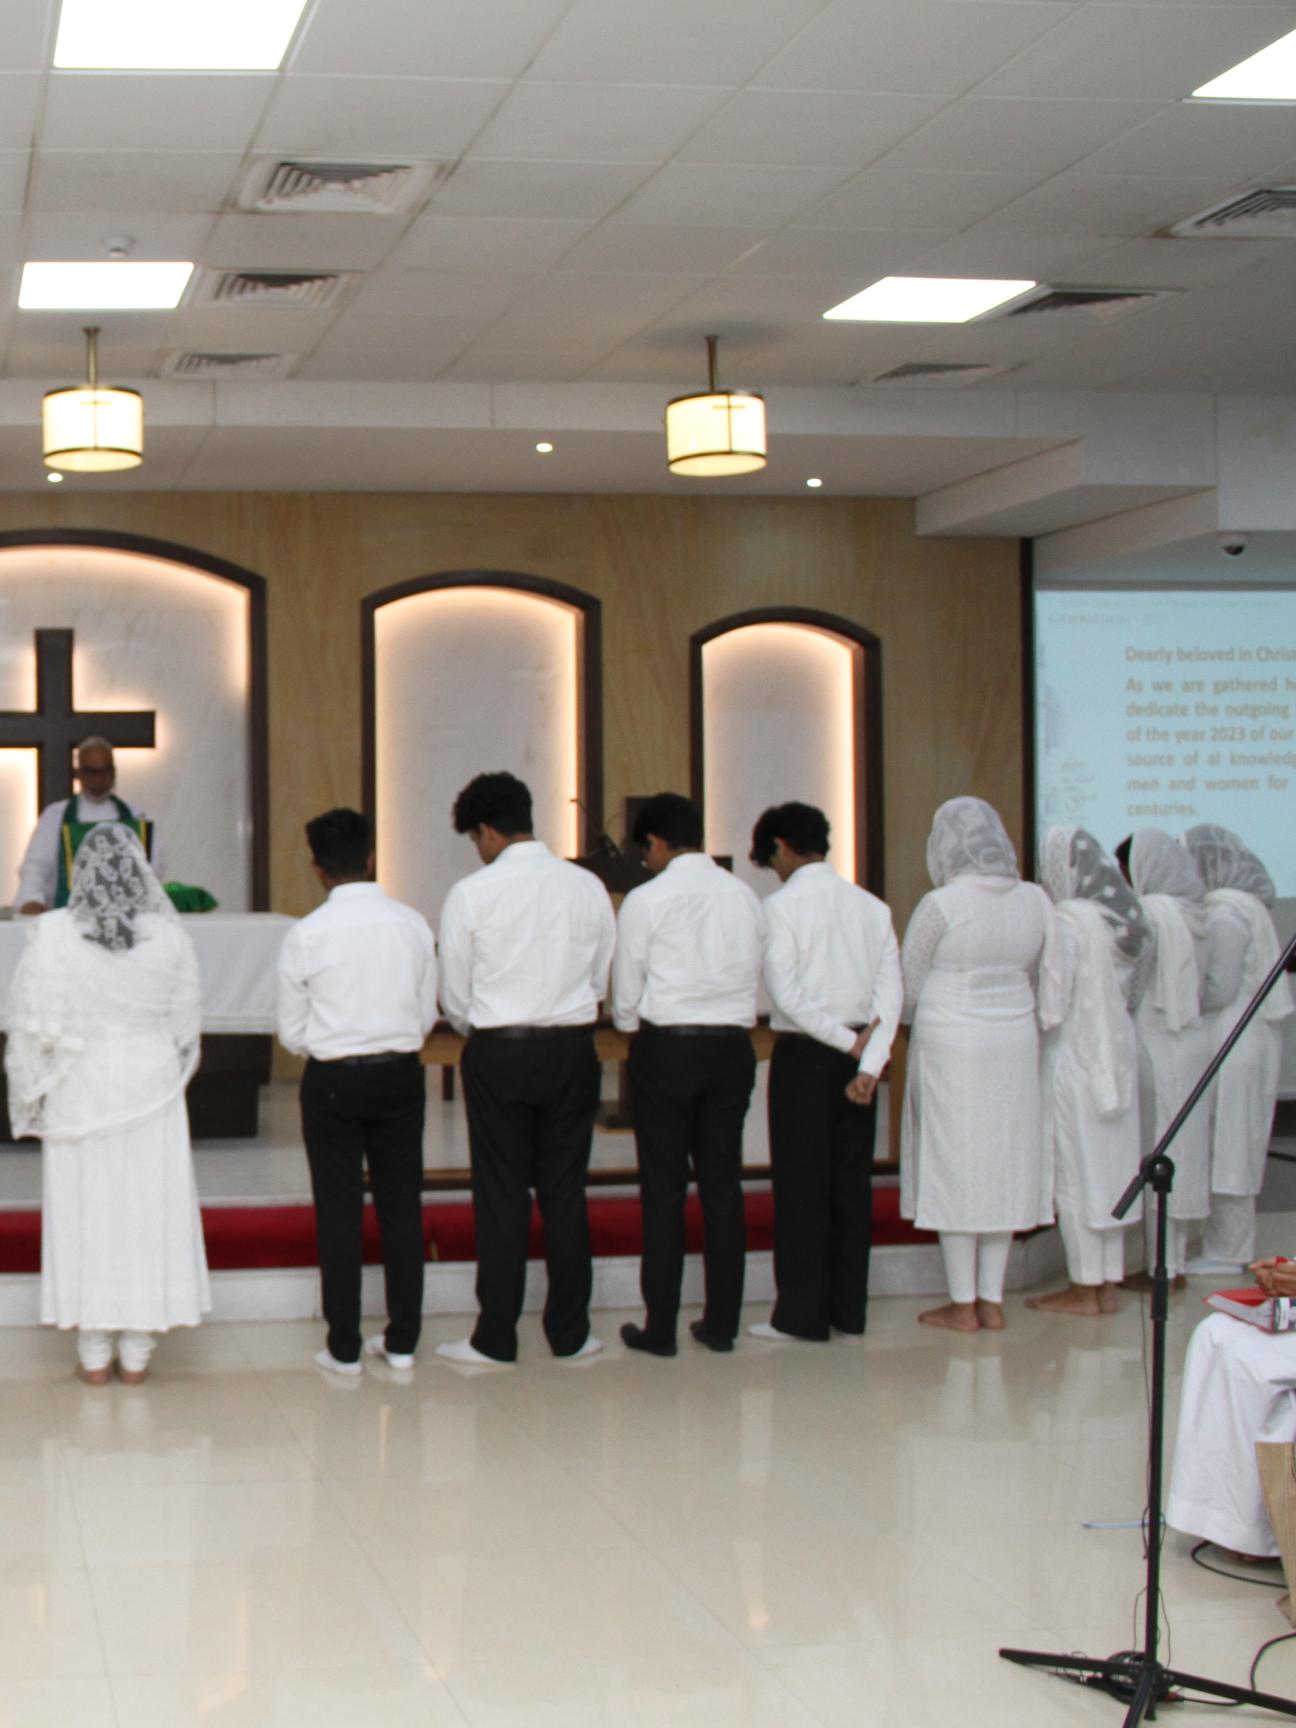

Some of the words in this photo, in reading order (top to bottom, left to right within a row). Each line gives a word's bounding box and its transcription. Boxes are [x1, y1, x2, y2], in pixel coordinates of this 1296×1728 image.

[1127, 646, 1173, 665] Dearly
[1176, 646, 1234, 663] beloved
[1239, 646, 1251, 662] in
[1127, 677, 1143, 694] As
[1153, 680, 1173, 693] we
[1182, 680, 1204, 694] are
[1213, 677, 1277, 696] gathered
[1127, 701, 1188, 717] dedicate
[1195, 702, 1218, 717] the
[1226, 702, 1289, 721] outgoing
[1127, 726, 1141, 743] of
[1147, 726, 1170, 742] the
[1175, 729, 1205, 745] year
[1211, 726, 1245, 742] 2023
[1250, 726, 1265, 742] of
[1270, 728, 1293, 741] our
[1127, 754, 1175, 769] source
[1184, 750, 1199, 767] of
[1208, 751, 1220, 766] al
[1127, 778, 1159, 792] men
[1169, 775, 1196, 791] and
[1205, 777, 1259, 791] women
[1269, 774, 1288, 790] for
[1128, 801, 1198, 818] centuries.
